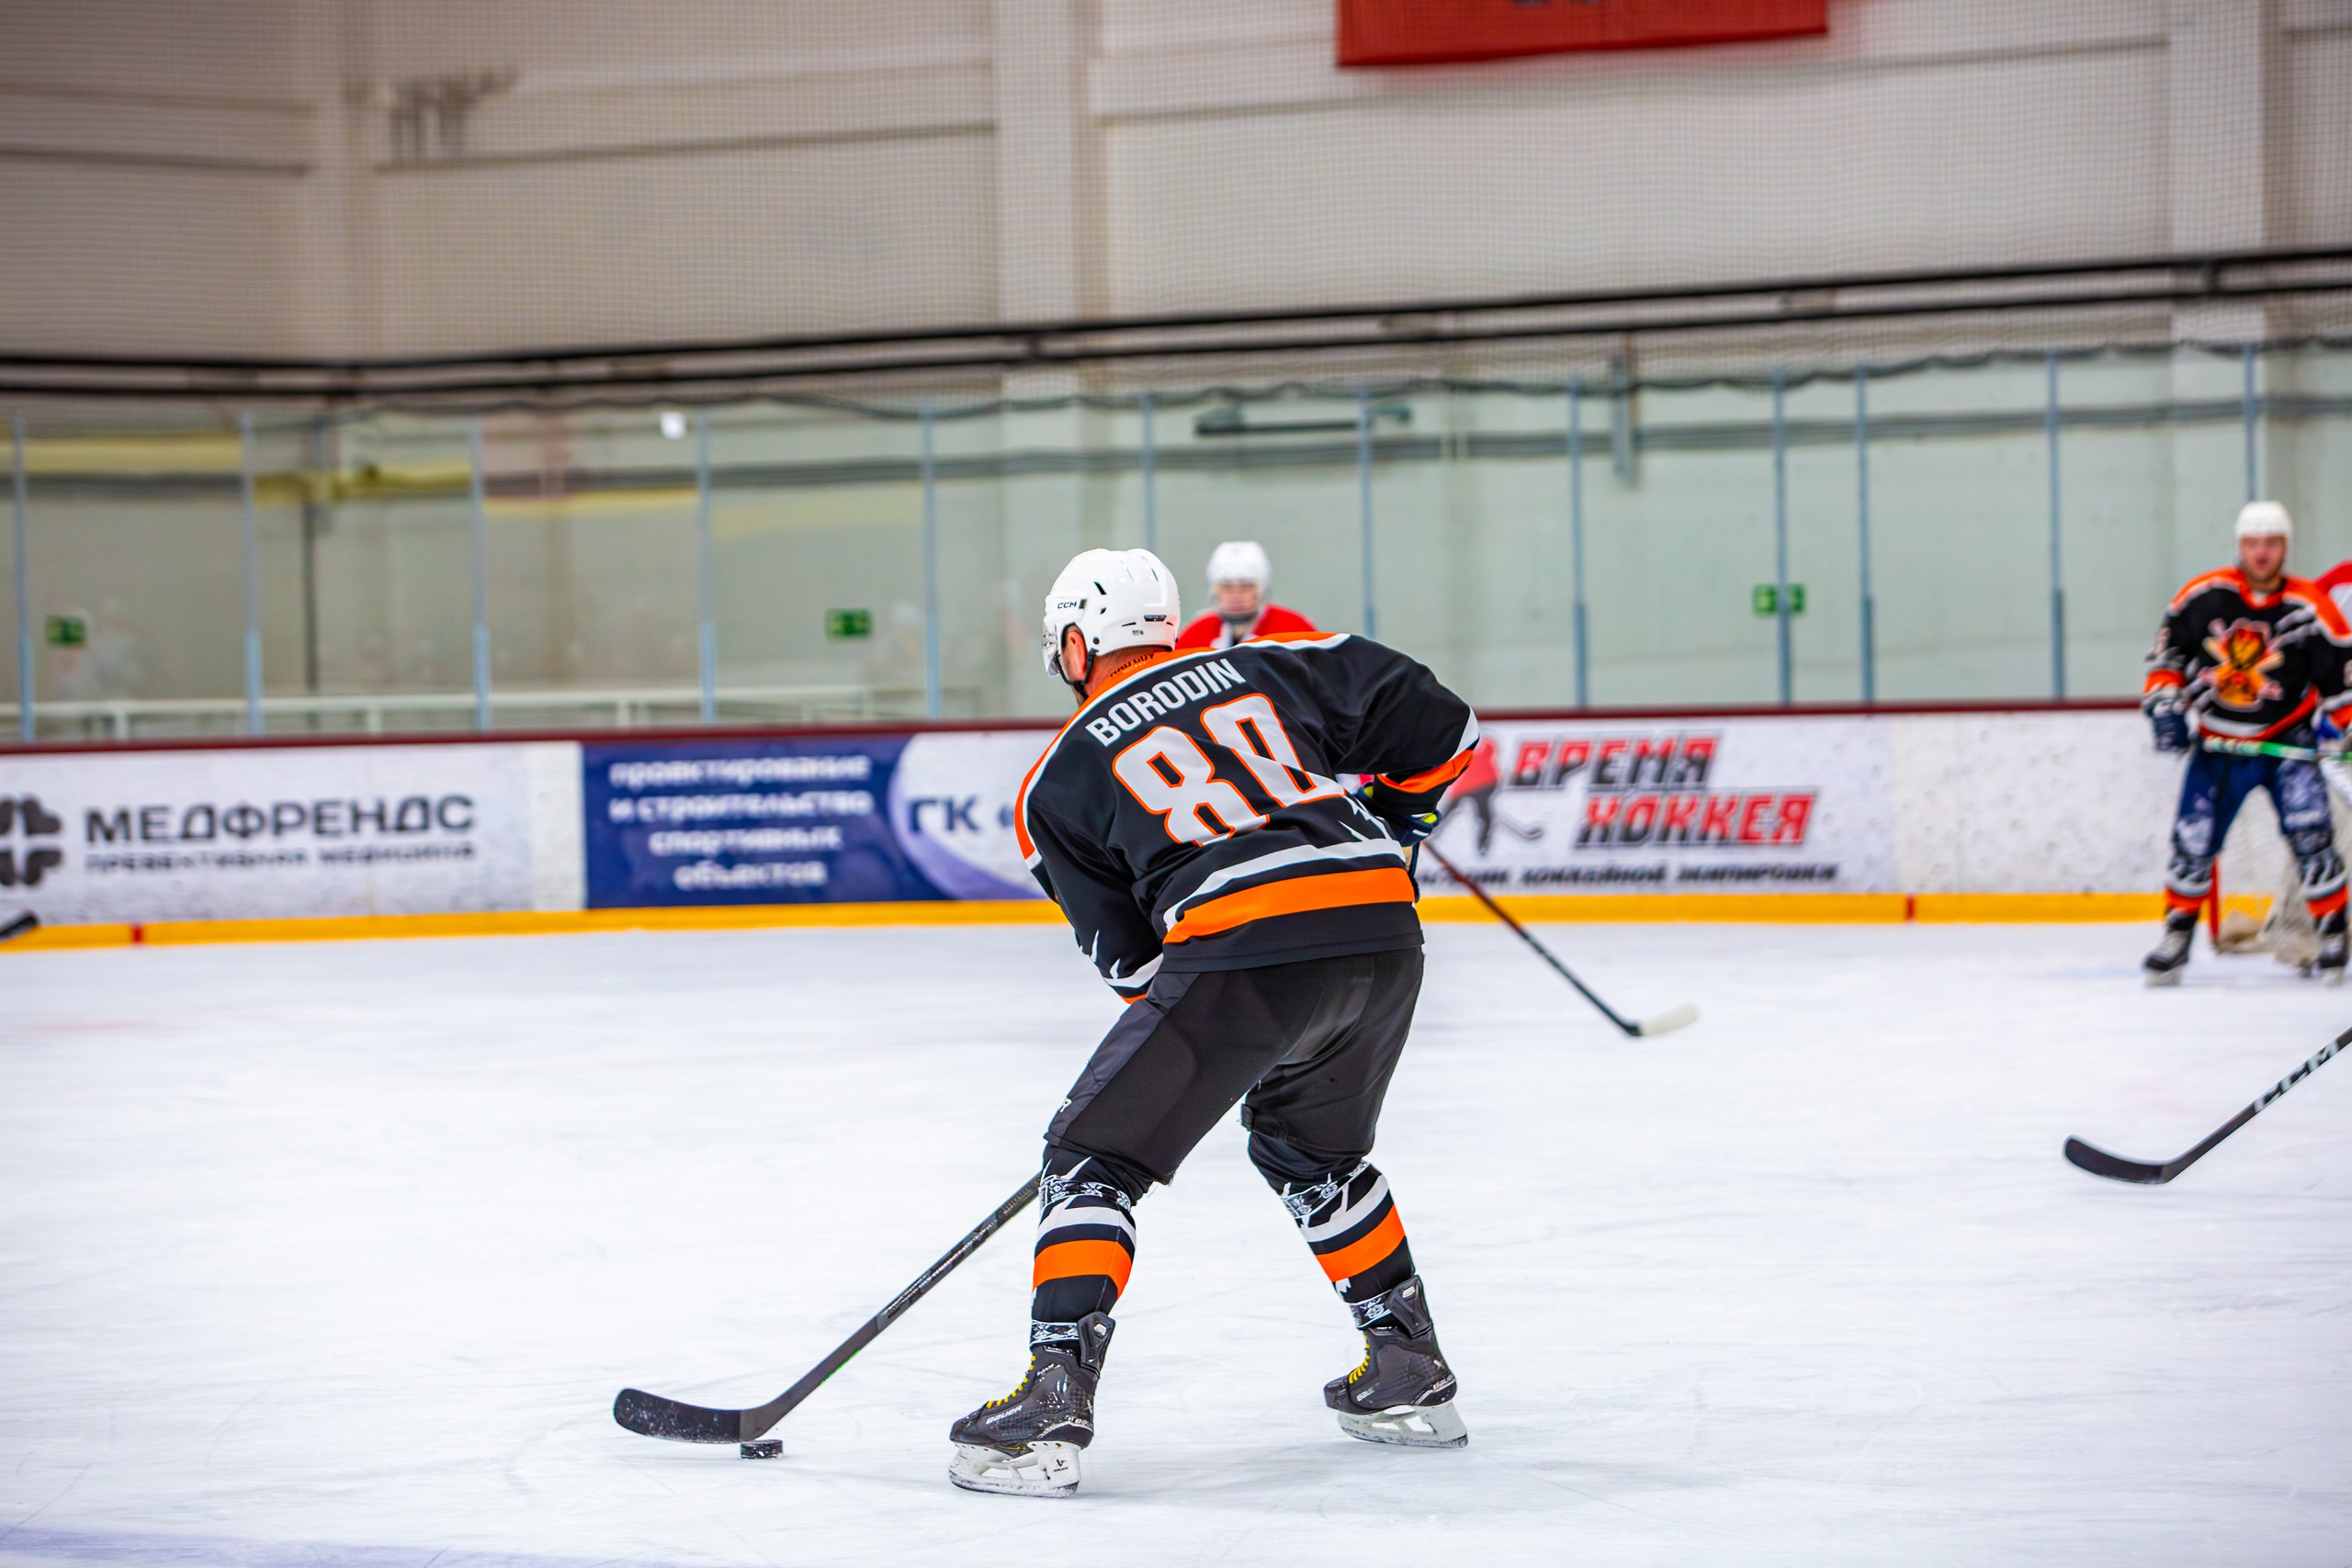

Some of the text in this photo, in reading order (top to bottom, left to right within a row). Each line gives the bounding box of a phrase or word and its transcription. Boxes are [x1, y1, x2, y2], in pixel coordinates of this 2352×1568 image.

[1057, 601, 1078, 609] CCM
[1133, 652, 1155, 665] GUY
[1084, 658, 1247, 747] BORODIN
[1112, 693, 1346, 847] 80
[1512, 736, 1718, 786] ВРЕМЯ
[85, 795, 475, 843] МЕДФРЕНДС
[910, 795, 980, 831] ГК
[1576, 793, 1814, 847] ХОККЕЯ
[986, 1405, 1023, 1425] BAUER
